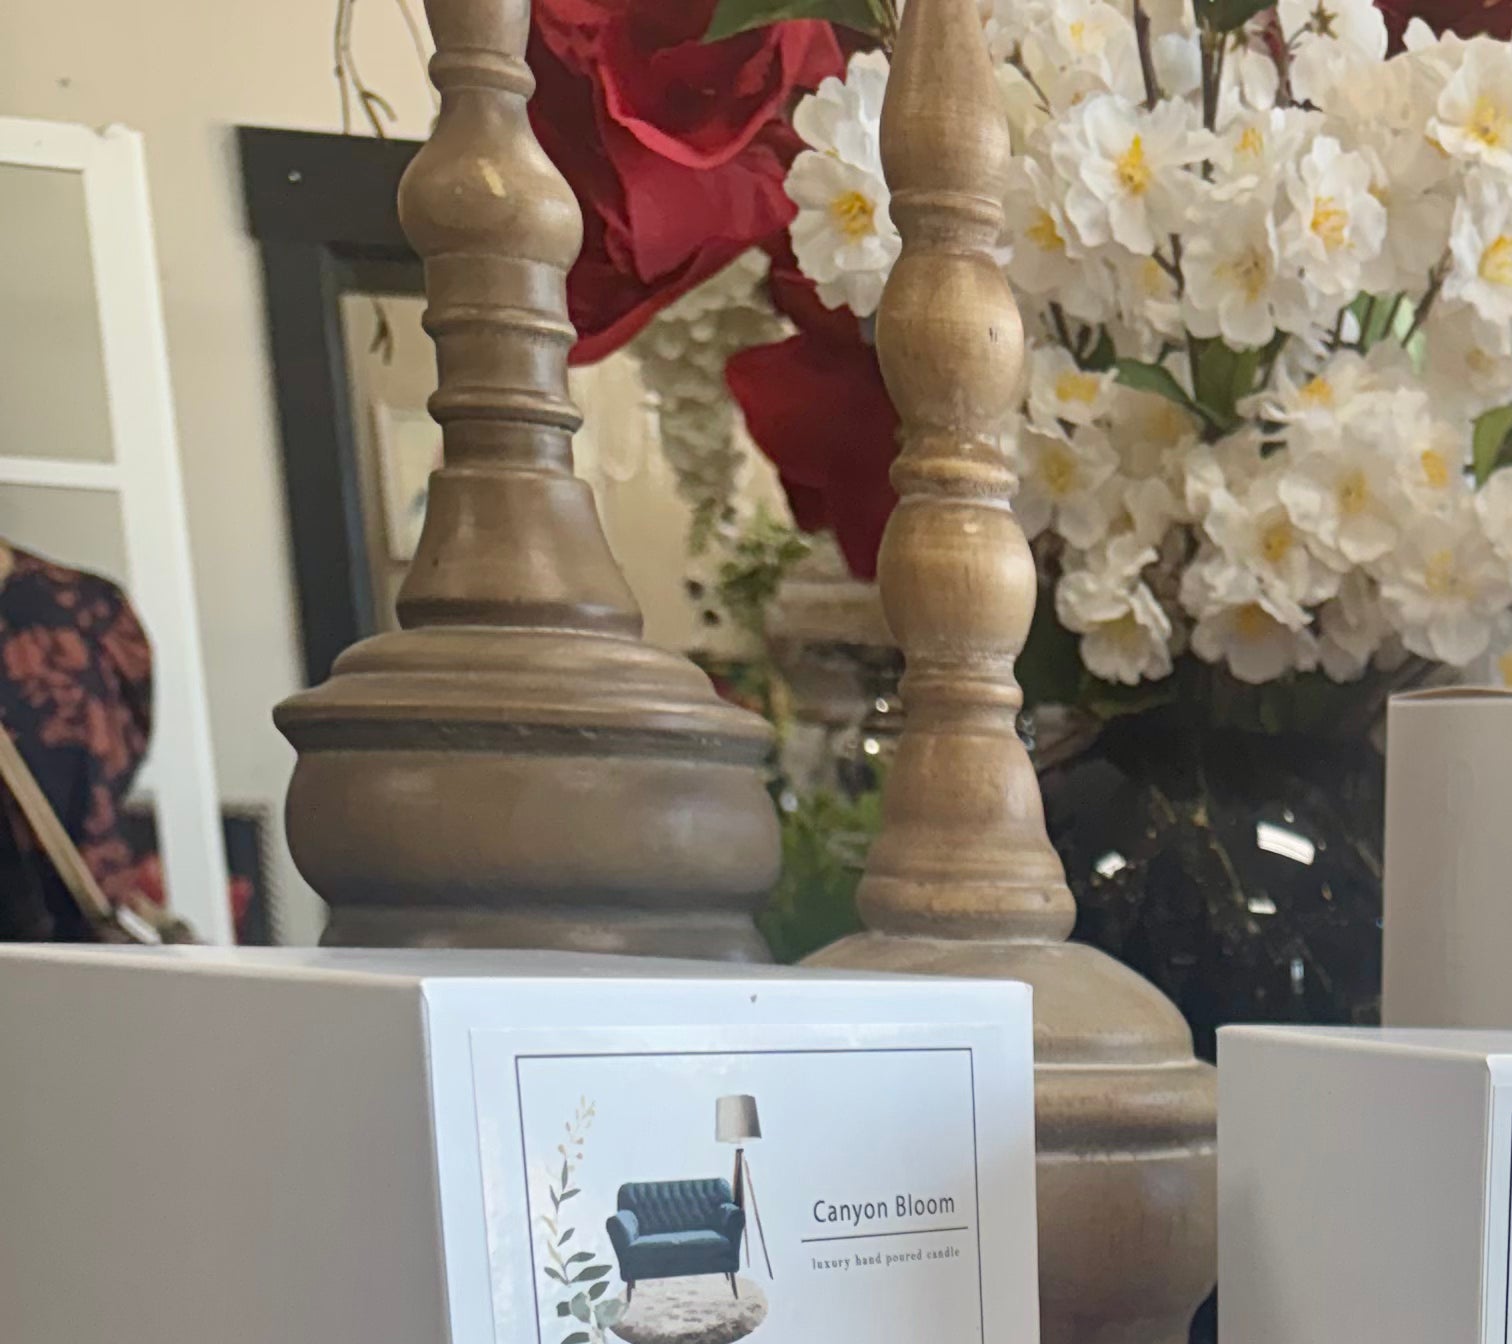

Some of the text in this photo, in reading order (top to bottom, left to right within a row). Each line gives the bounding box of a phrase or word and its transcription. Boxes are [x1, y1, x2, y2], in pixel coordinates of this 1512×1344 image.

[813, 1193, 955, 1227] Canyon Bloom
[812, 1246, 960, 1271] luxury hand poured candle
